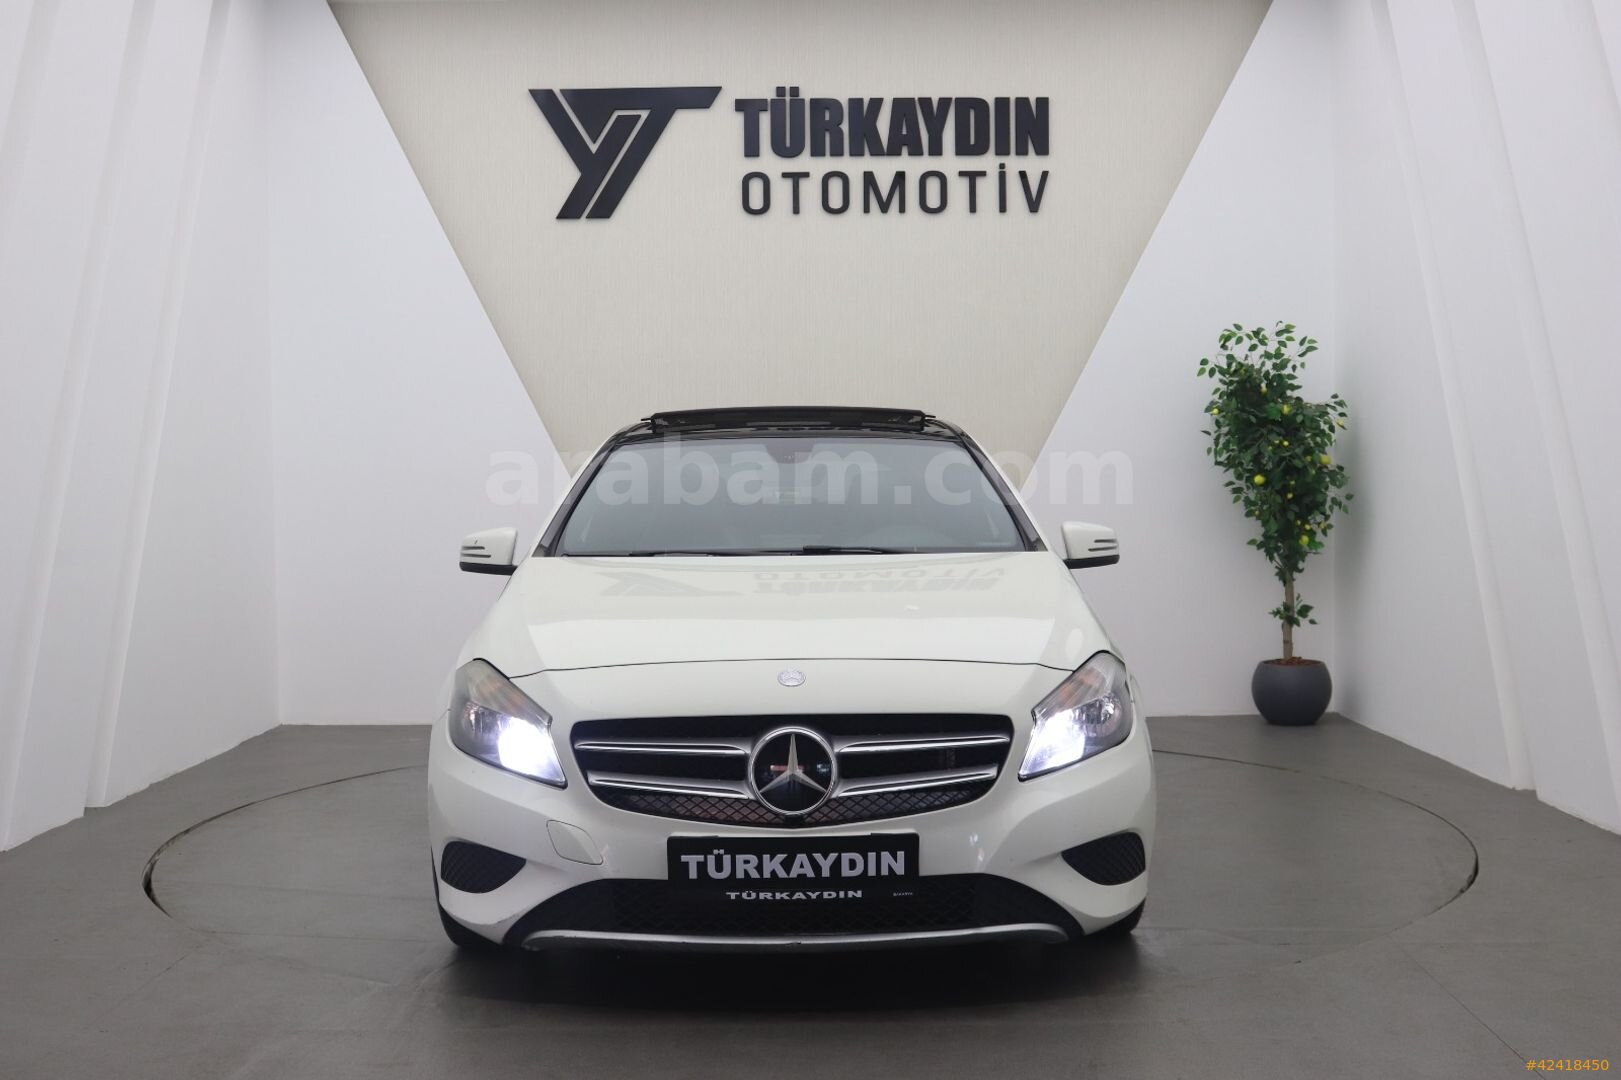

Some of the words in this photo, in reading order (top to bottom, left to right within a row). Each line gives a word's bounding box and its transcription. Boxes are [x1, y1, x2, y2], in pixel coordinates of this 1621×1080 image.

[734, 86, 1050, 158] TÜRKAYDIN
[741, 163, 1050, 215] OTOMOTİV
[680, 849, 905, 880] TÜRKAYDIN
[726, 890, 862, 900] TÜRKAYDIN
